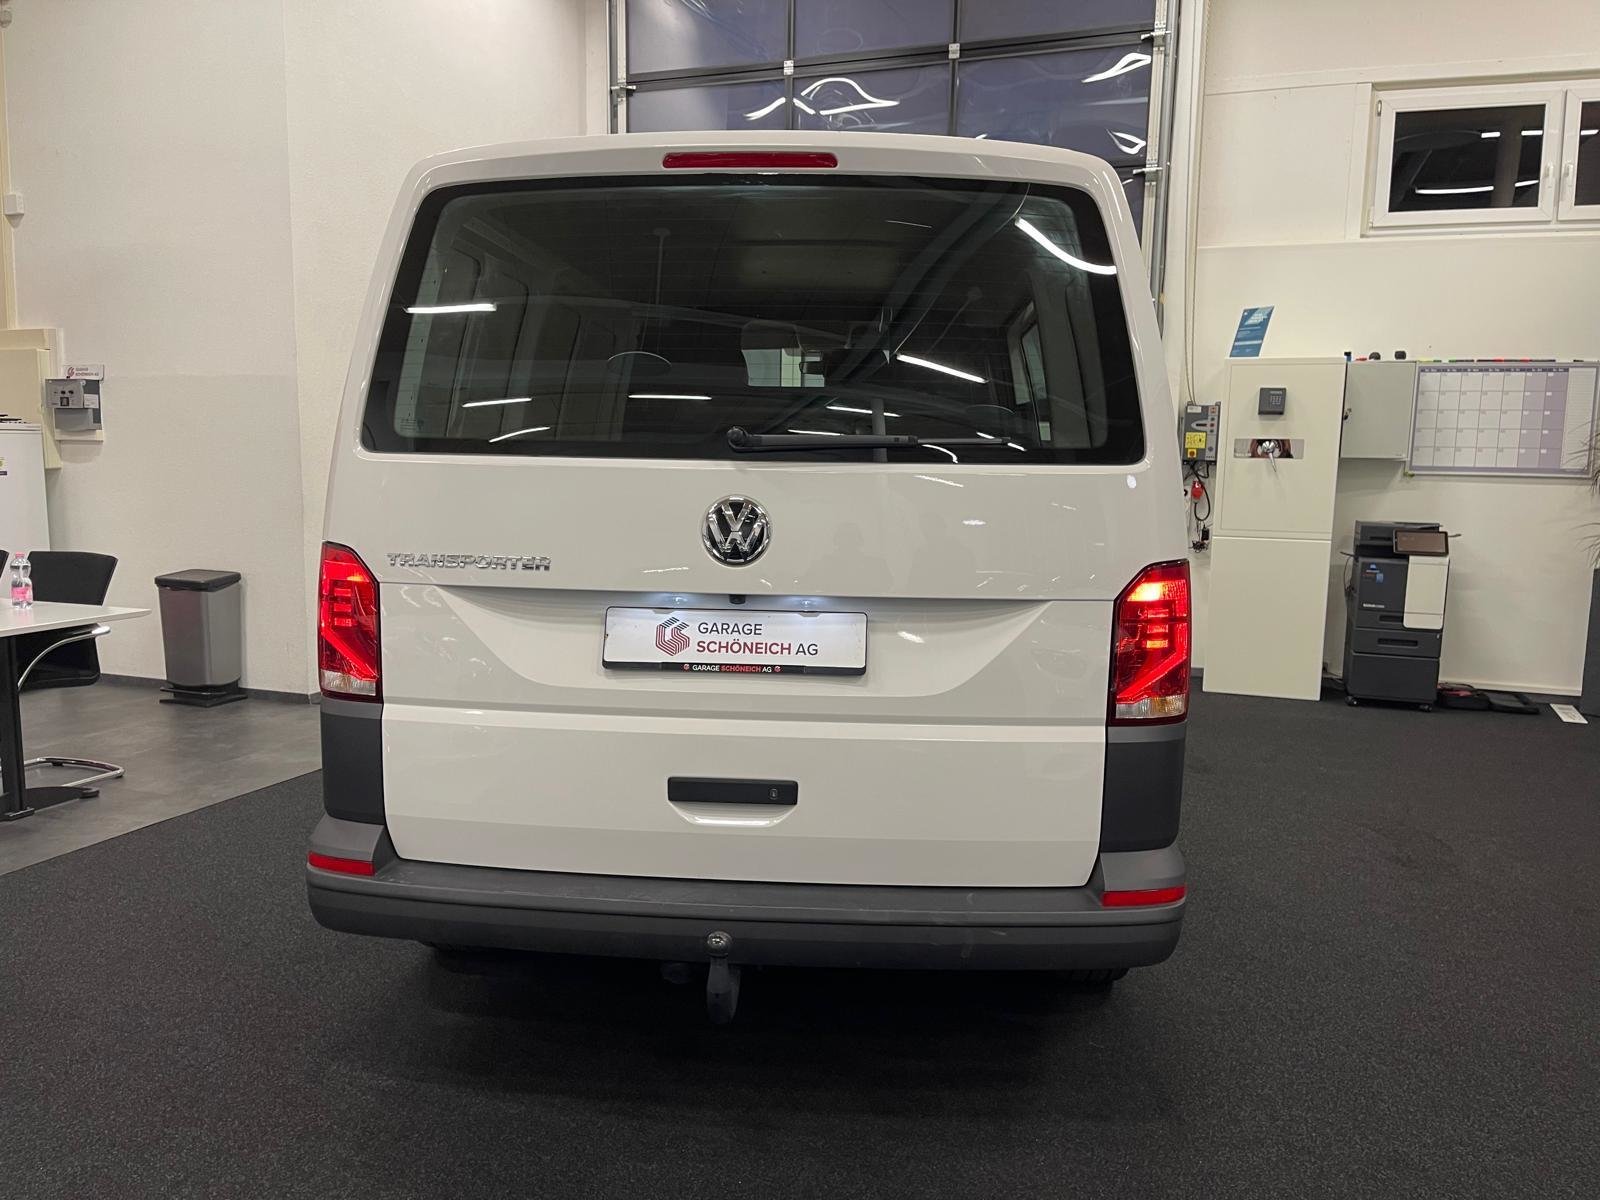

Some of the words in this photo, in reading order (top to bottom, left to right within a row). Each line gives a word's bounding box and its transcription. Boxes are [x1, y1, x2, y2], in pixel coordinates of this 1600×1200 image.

[387, 552, 551, 571] TRANSPORTER
[698, 622, 763, 636] GARAGE
[696, 638, 792, 655] SCHÖNEICH
[795, 643, 819, 656] AG
[692, 664, 720, 672] GARAGE
[720, 665, 761, 673] SCHÖNEICH
